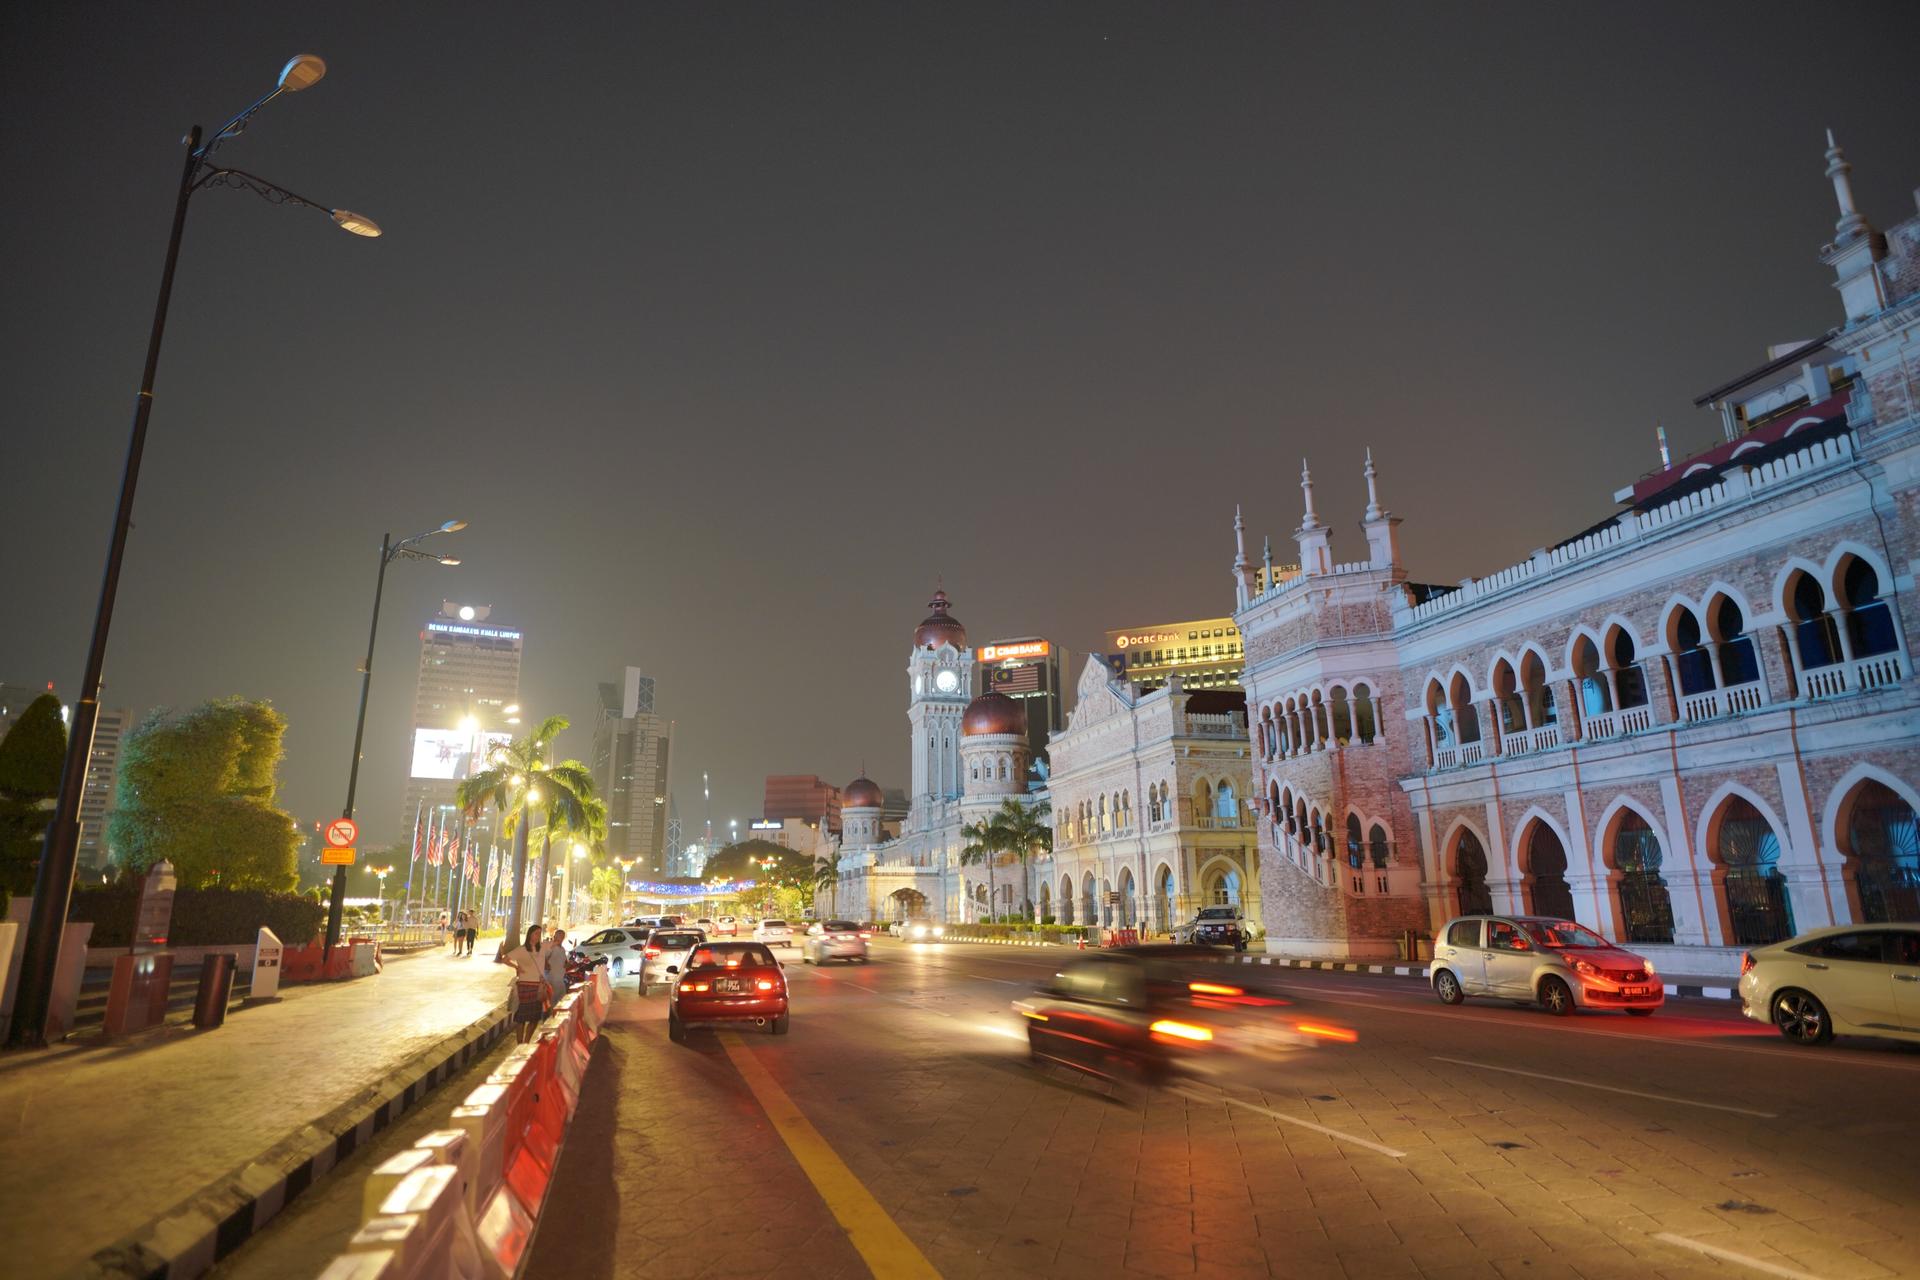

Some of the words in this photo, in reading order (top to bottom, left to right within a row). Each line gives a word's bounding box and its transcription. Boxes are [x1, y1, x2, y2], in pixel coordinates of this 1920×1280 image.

[480, 629, 498, 637] KUALA
[1130, 635, 1156, 645] OCBC
[1157, 633, 1180, 642] Bank
[997, 646, 1019, 656] CIMB
[1019, 643, 1042, 654] BANK
